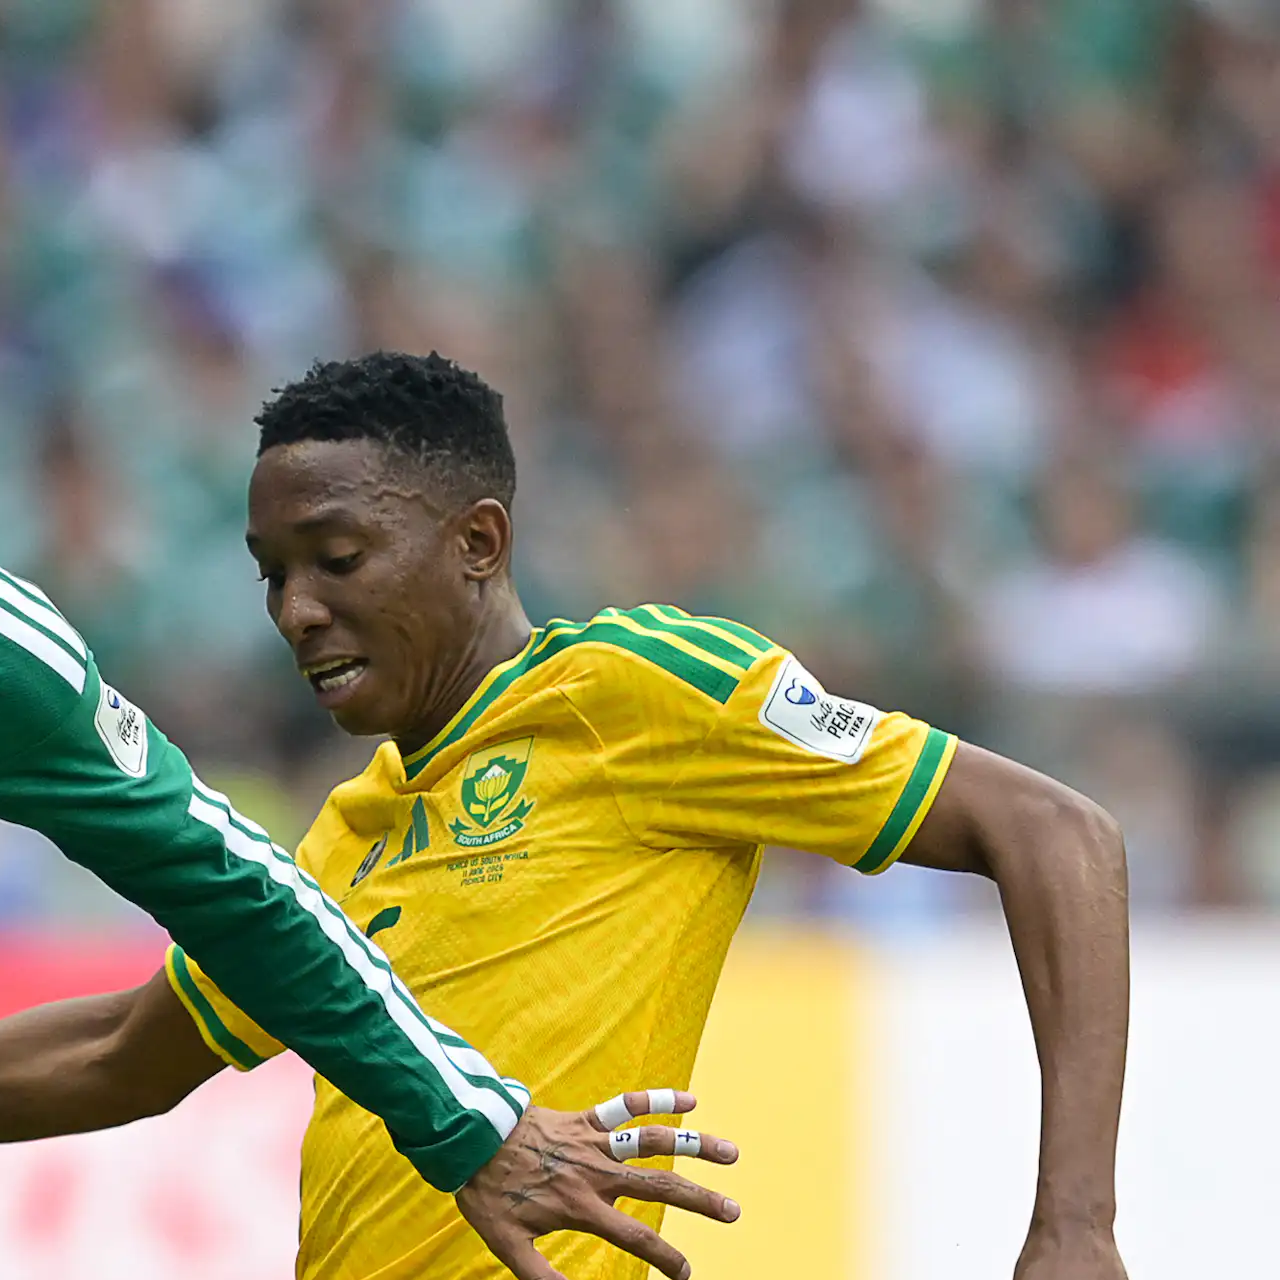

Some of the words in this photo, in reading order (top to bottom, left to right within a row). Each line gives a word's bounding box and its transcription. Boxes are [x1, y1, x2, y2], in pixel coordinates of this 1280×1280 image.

[827, 704, 856, 739] PEAC
[848, 716, 865, 738] FIFA
[457, 834, 482, 845] SOUTH
[483, 823, 517, 844] AFRICA
[487, 873, 503, 882] CITY
